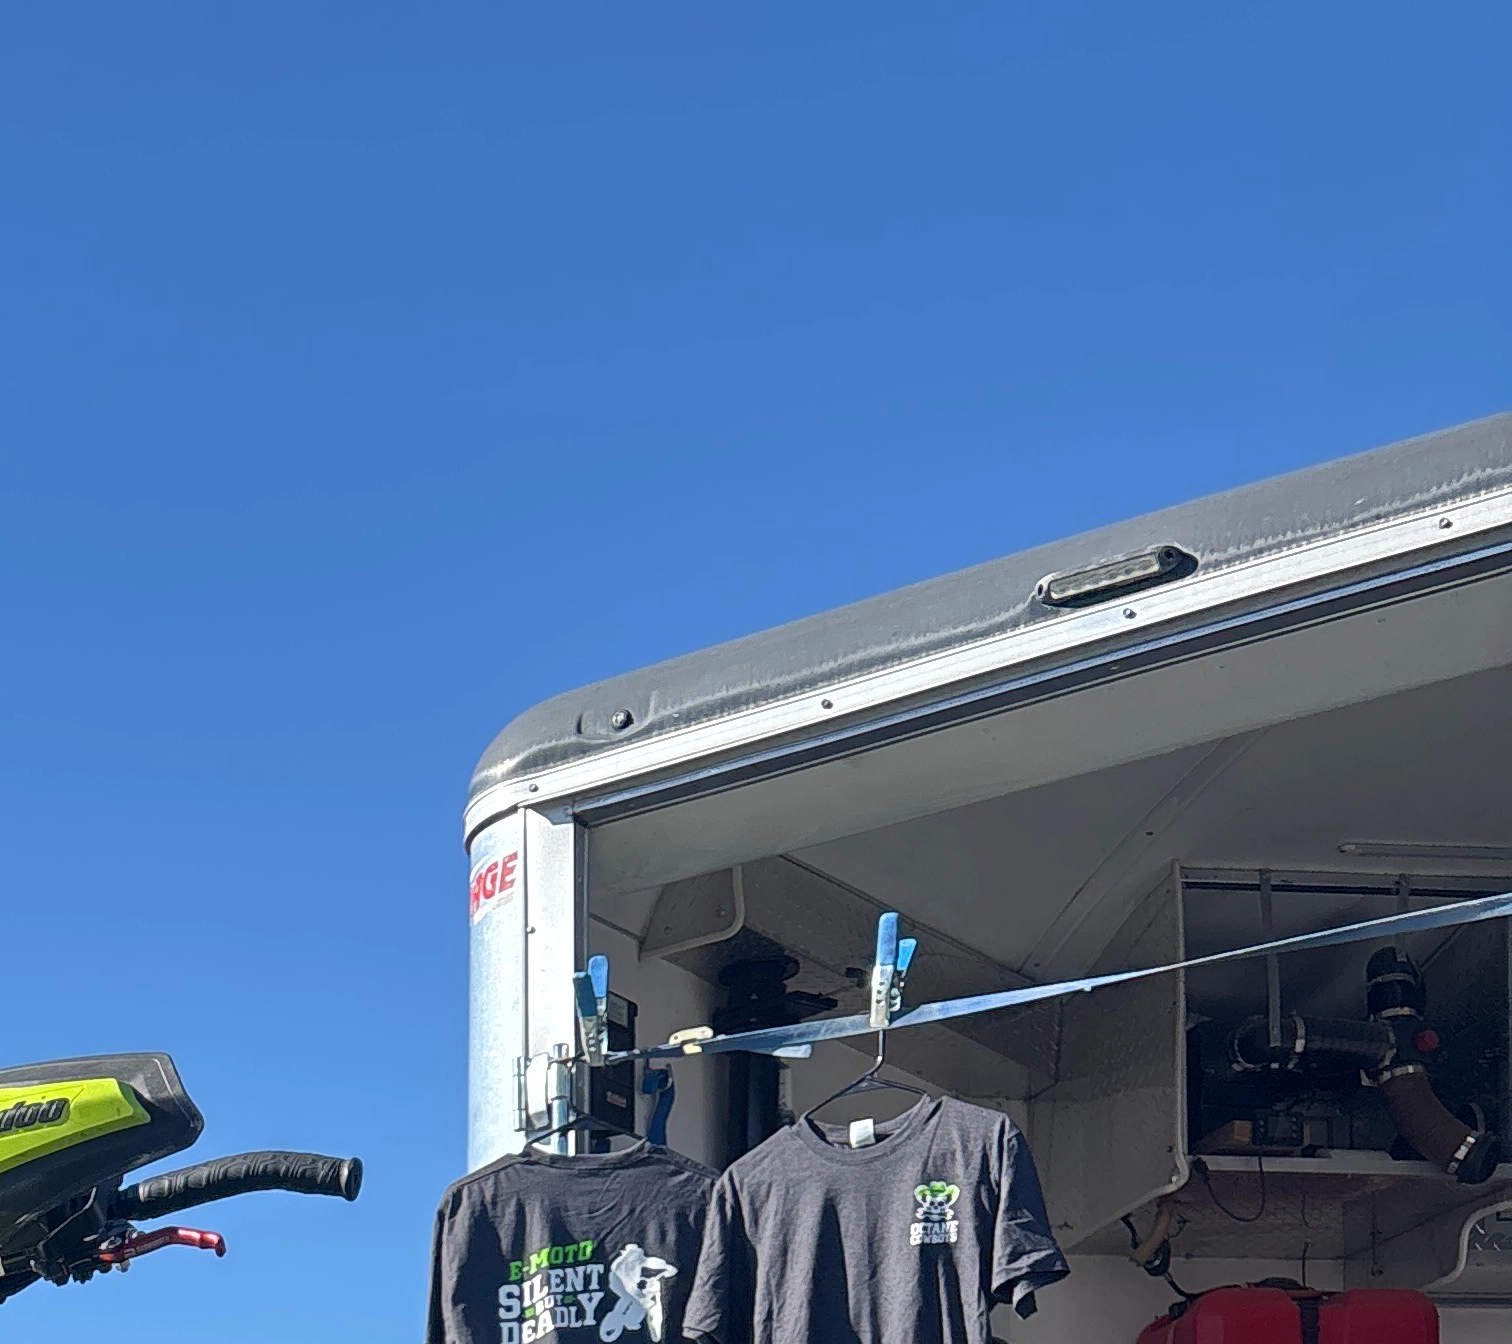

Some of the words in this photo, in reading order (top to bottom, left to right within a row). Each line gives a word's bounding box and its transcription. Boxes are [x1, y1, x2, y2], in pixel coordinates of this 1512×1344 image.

[910, 1220, 959, 1235] OCTANE
[509, 1240, 594, 1281] E-MOTO
[498, 1264, 605, 1320] SILENT
